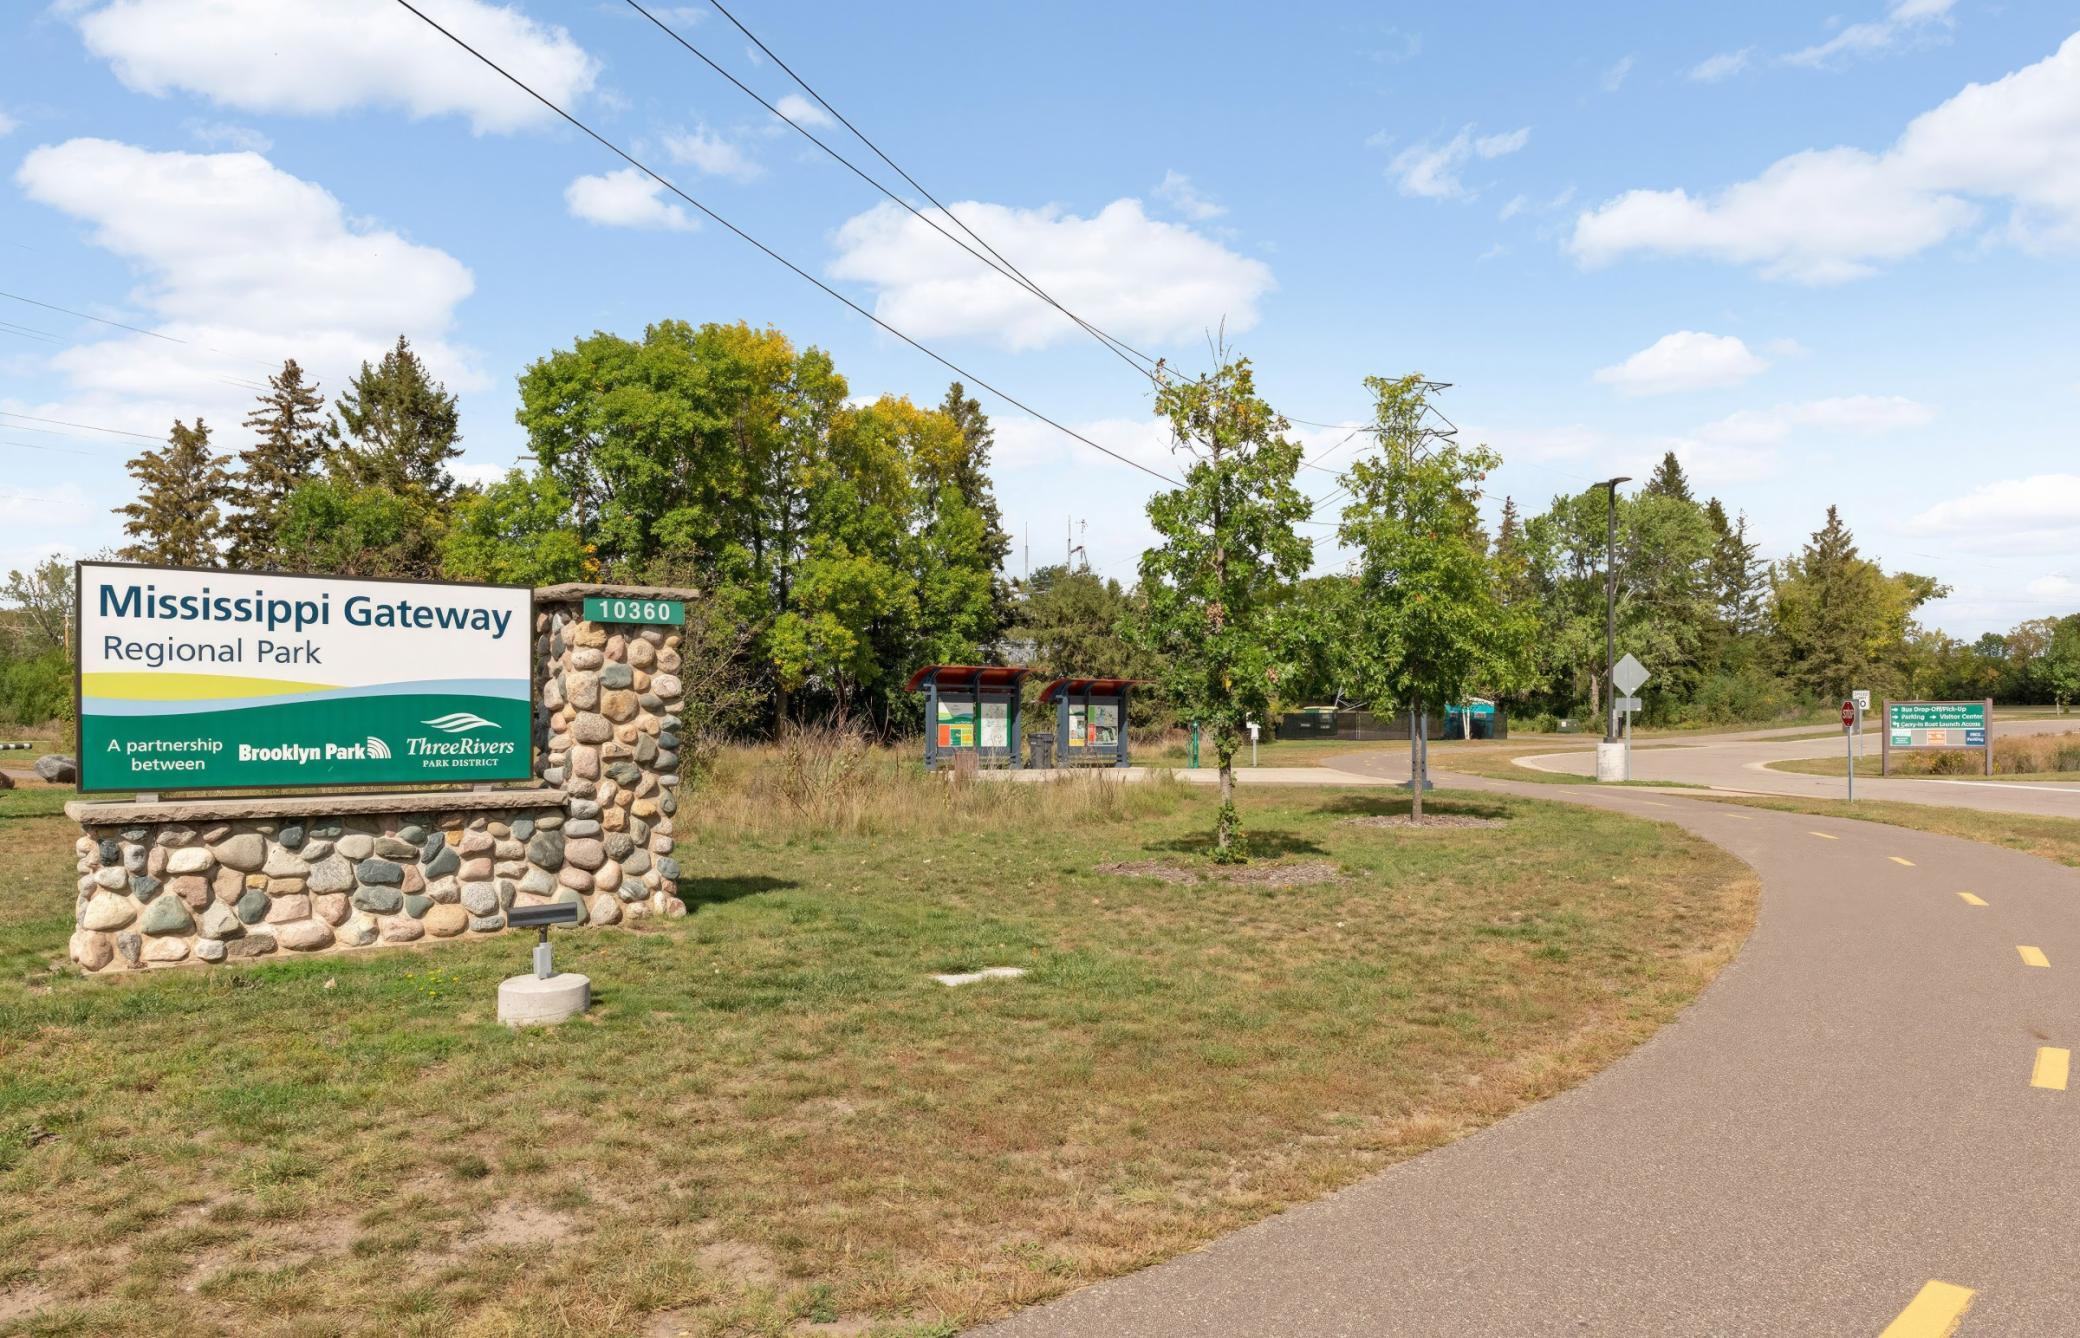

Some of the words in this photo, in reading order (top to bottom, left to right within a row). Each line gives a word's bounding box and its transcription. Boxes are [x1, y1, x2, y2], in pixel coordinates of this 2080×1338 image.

[100, 584, 330, 632] Mississippi
[344, 594, 513, 639] Gateway
[599, 601, 671, 622] 10360
[104, 636, 243, 668] Regional
[257, 640, 322, 664] Park
[1842, 709, 1854, 719] STOP
[107, 739, 121, 752] A
[126, 738, 223, 758] partnership
[238, 743, 321, 765] Brooklyn
[325, 742, 366, 761] Park
[406, 737, 515, 755] ThreeRivers
[131, 757, 206, 771] between
[423, 759, 449, 767] PARK
[451, 758, 498, 767] DISTRICT
